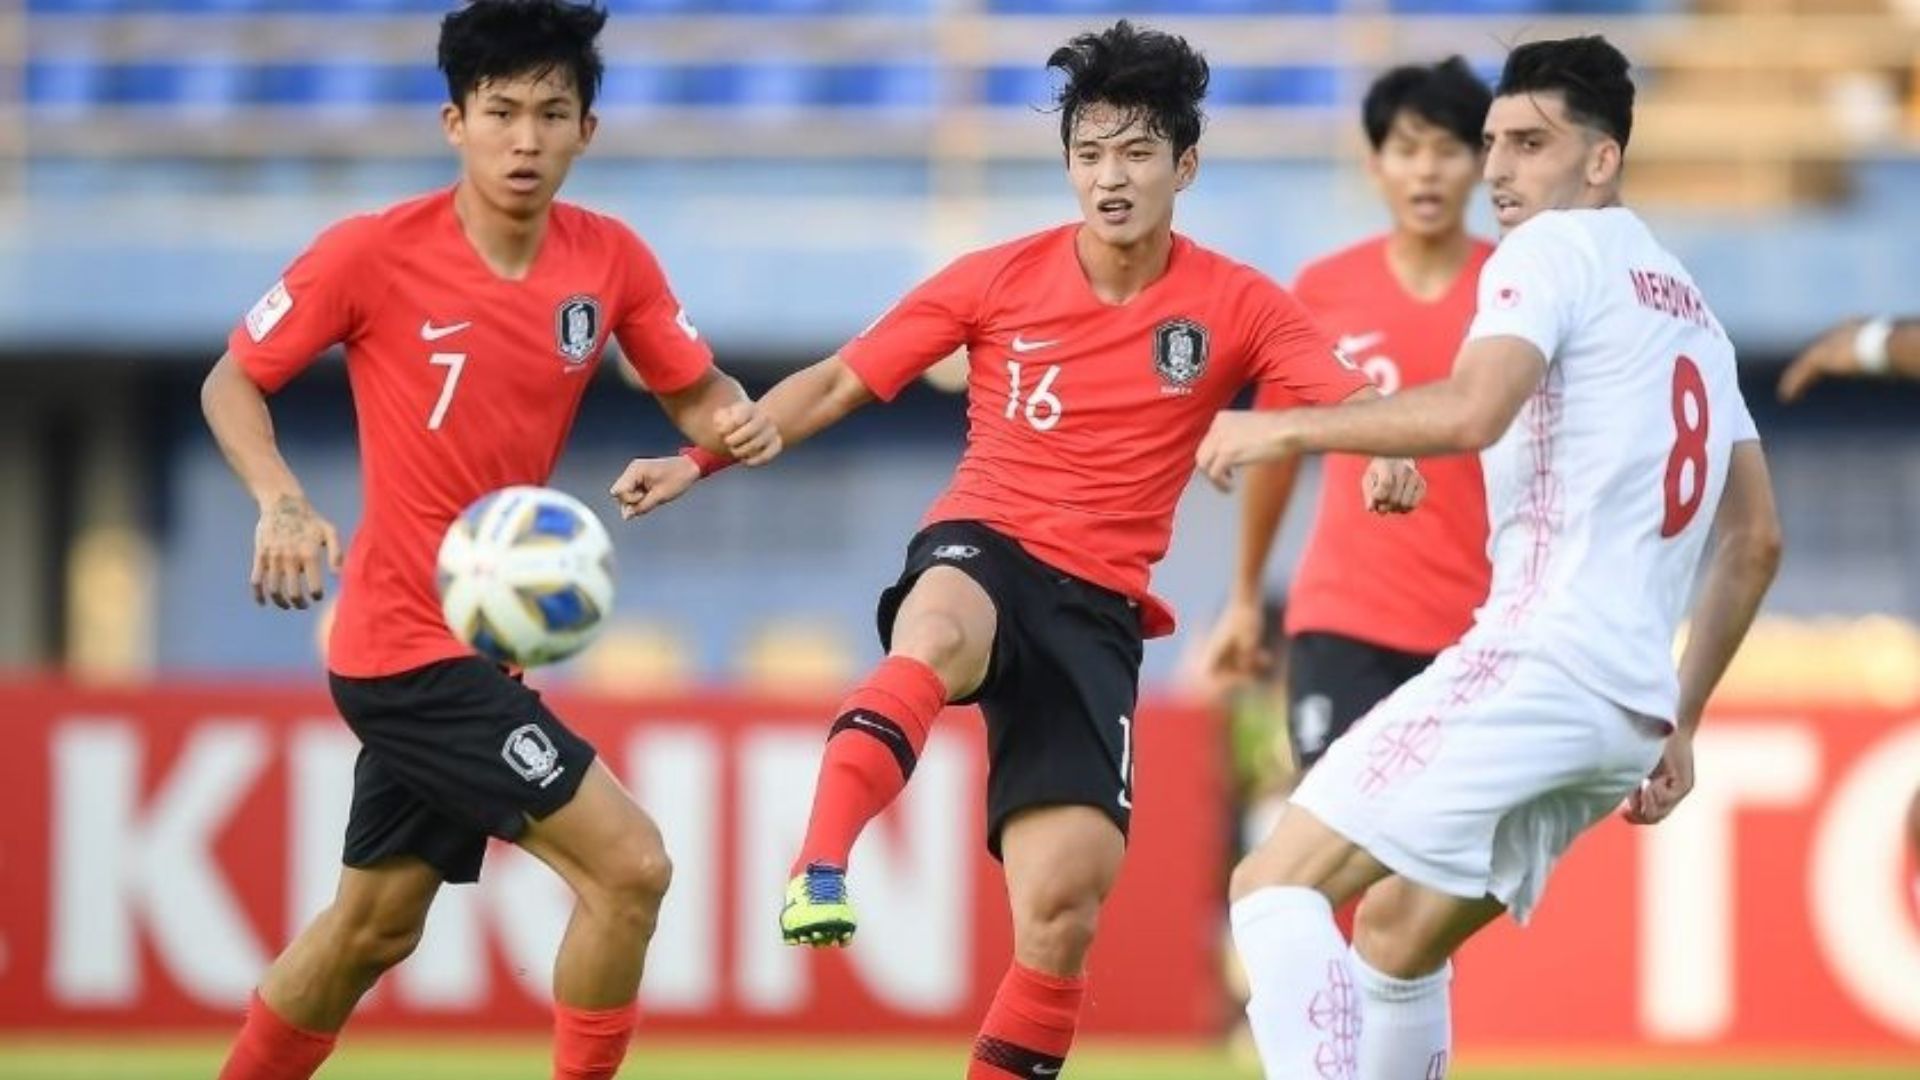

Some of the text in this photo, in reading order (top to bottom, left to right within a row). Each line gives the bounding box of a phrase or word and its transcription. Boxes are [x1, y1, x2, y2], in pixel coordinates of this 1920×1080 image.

[1629, 267, 1719, 337] MEHDIKH
[427, 352, 468, 431] 7
[1004, 360, 1063, 431] 16
[1661, 354, 1709, 540] 8
[1117, 714, 1134, 809] 1
